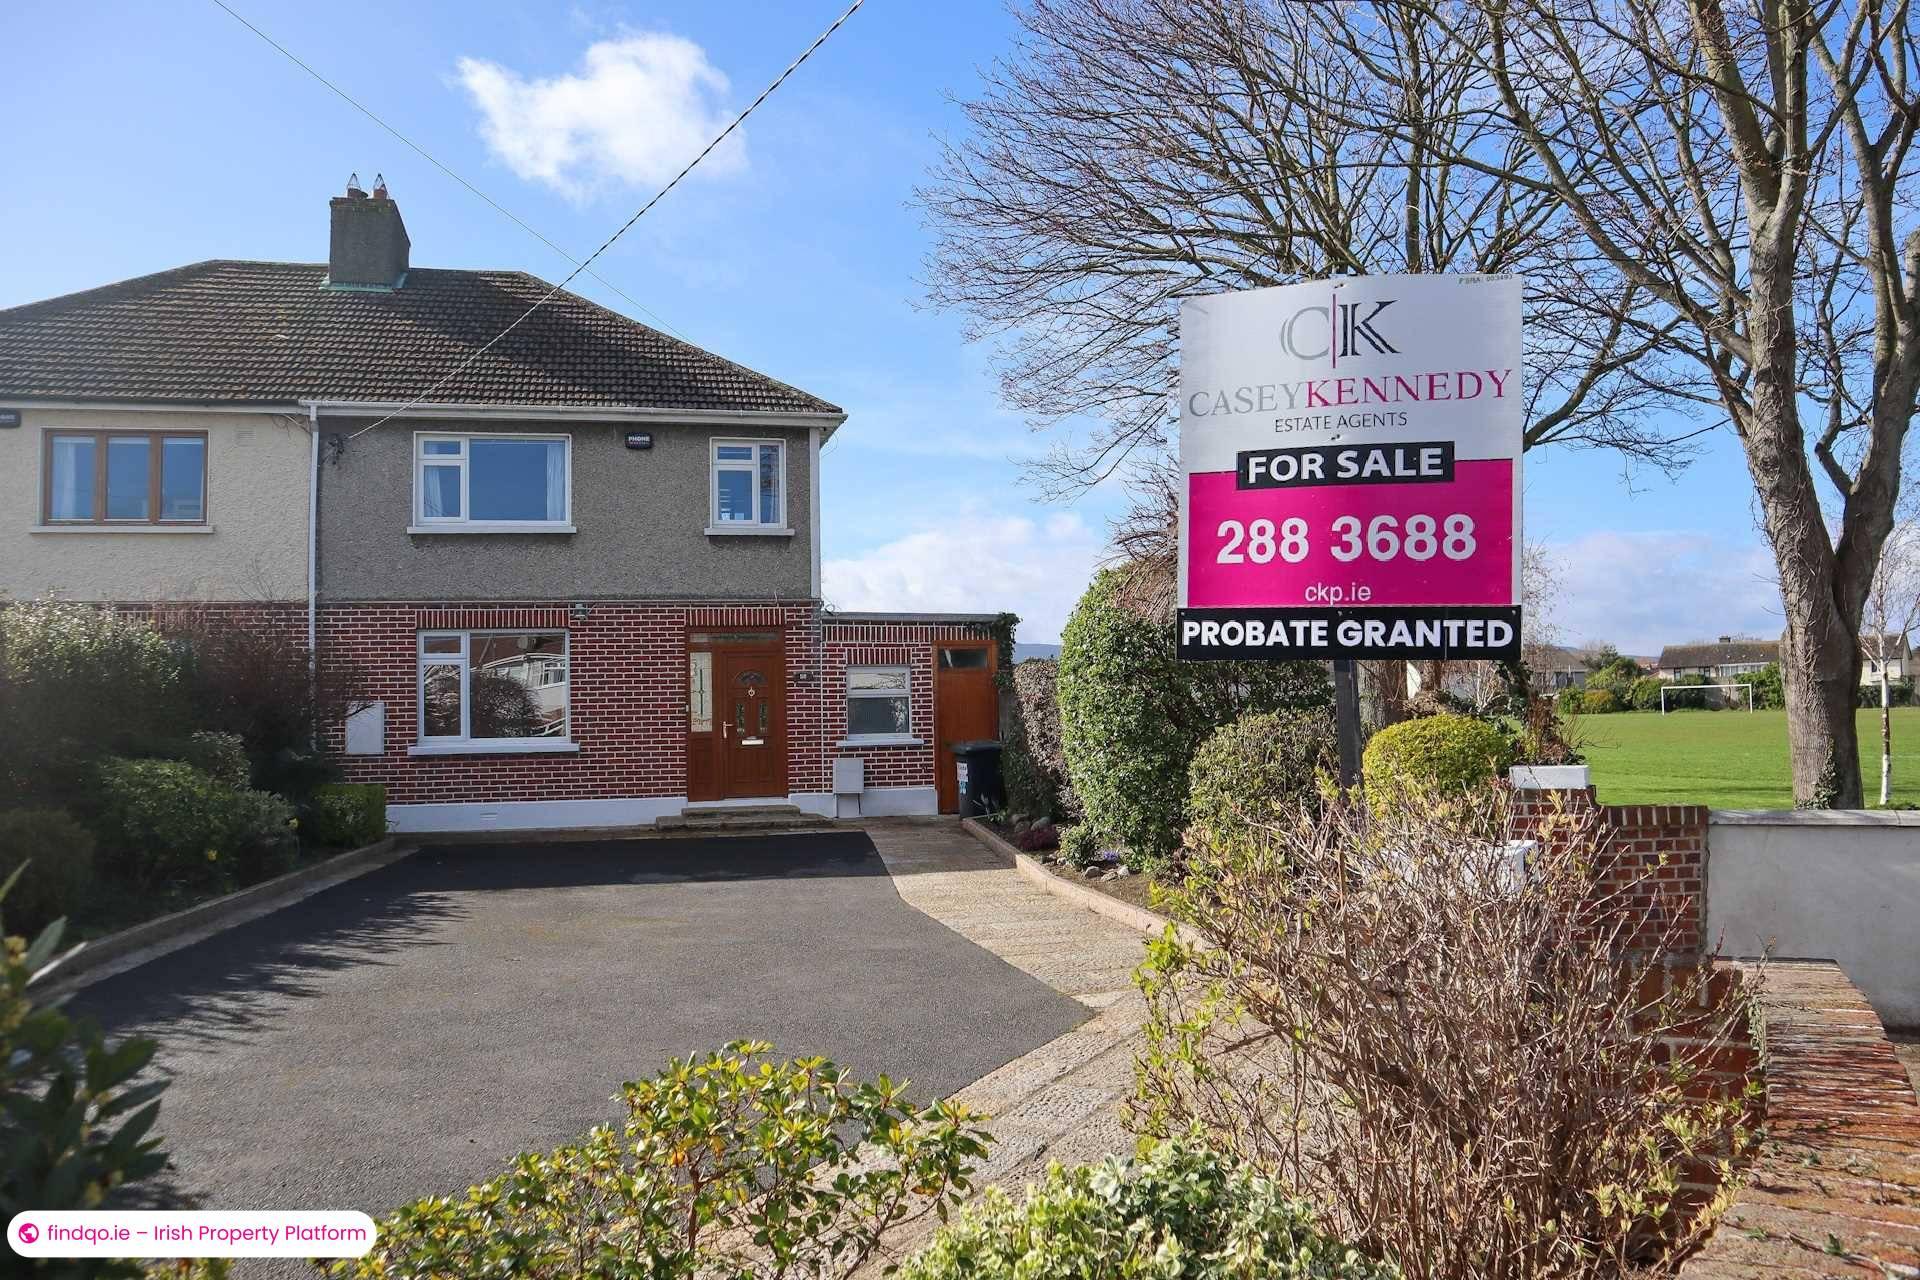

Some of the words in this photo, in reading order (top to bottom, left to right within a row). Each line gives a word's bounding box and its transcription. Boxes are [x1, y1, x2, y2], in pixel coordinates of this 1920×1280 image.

[1275, 414, 1332, 433] ESTATE
[1336, 411, 1408, 428] AGENTS
[1247, 453, 1325, 484] FOR
[1336, 447, 1443, 478] SALE
[1216, 517, 1309, 564] 288
[1330, 513, 1477, 562] 3688
[1304, 582, 1372, 606] ckp.ie
[1182, 619, 1329, 647] PROBATE
[1336, 618, 1514, 648] GRANTED
